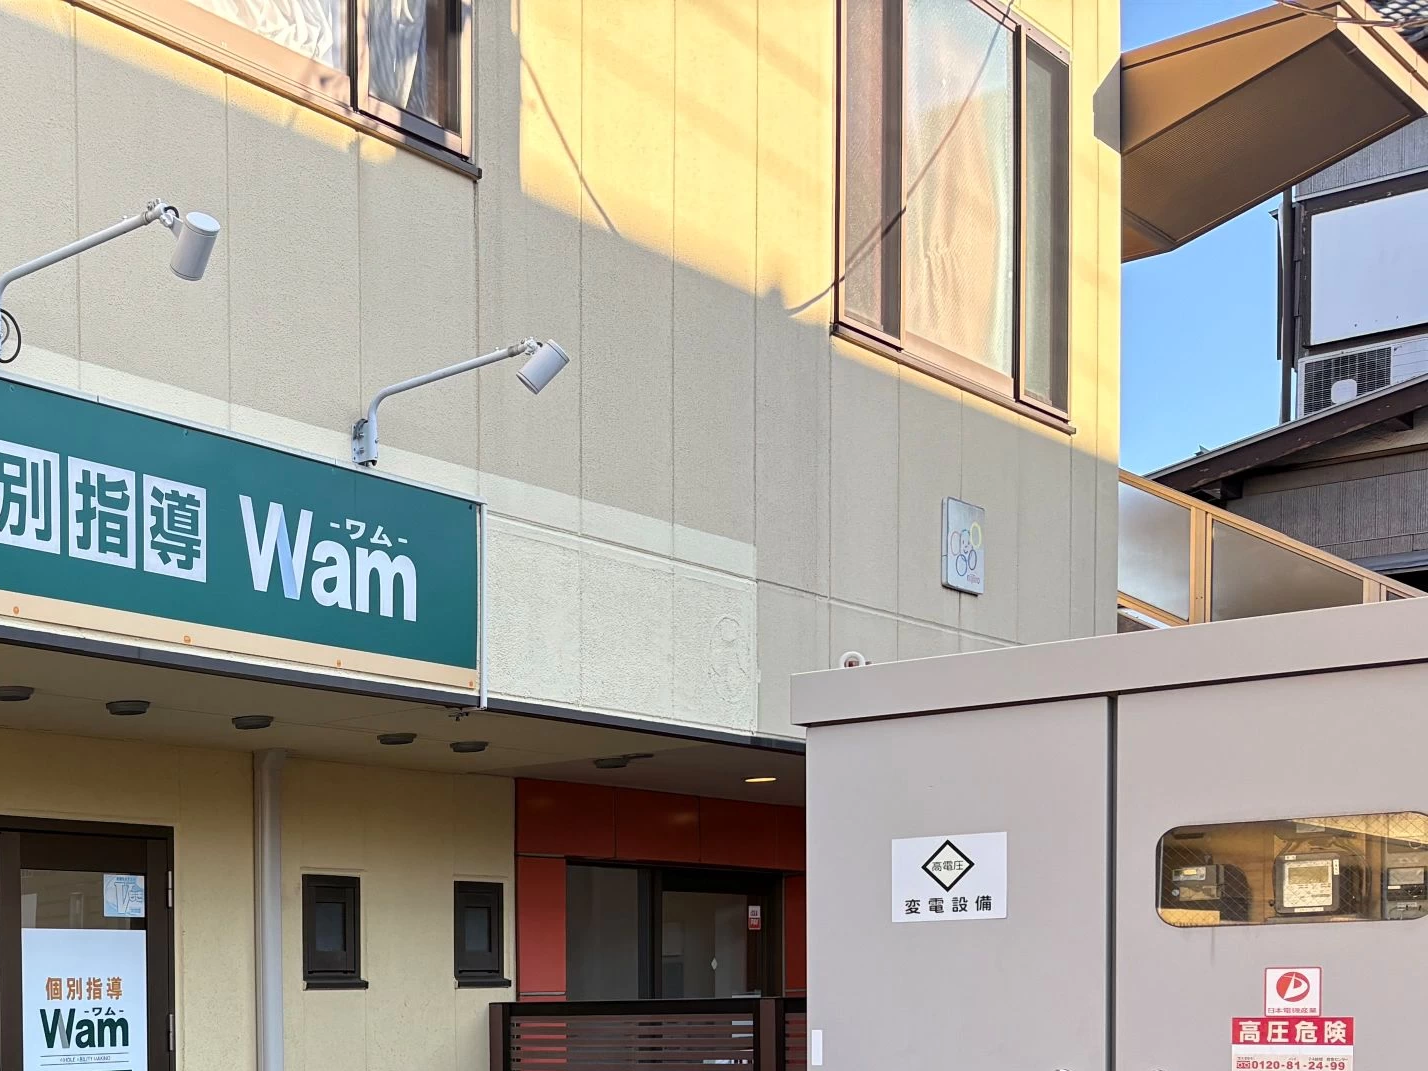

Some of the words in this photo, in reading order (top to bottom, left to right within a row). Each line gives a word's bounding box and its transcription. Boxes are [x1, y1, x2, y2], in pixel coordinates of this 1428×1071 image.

[239, 494, 417, 623] Wam
[932, 860, 964, 872] 高電圧
[905, 895, 992, 915] 変電設備
[46, 976, 123, 1001] 個別指導
[39, 1007, 129, 1049] Wam
[1238, 1020, 1347, 1044] 高圧危険
[1252, 1061, 1346, 1071] 0120-81-24-99
